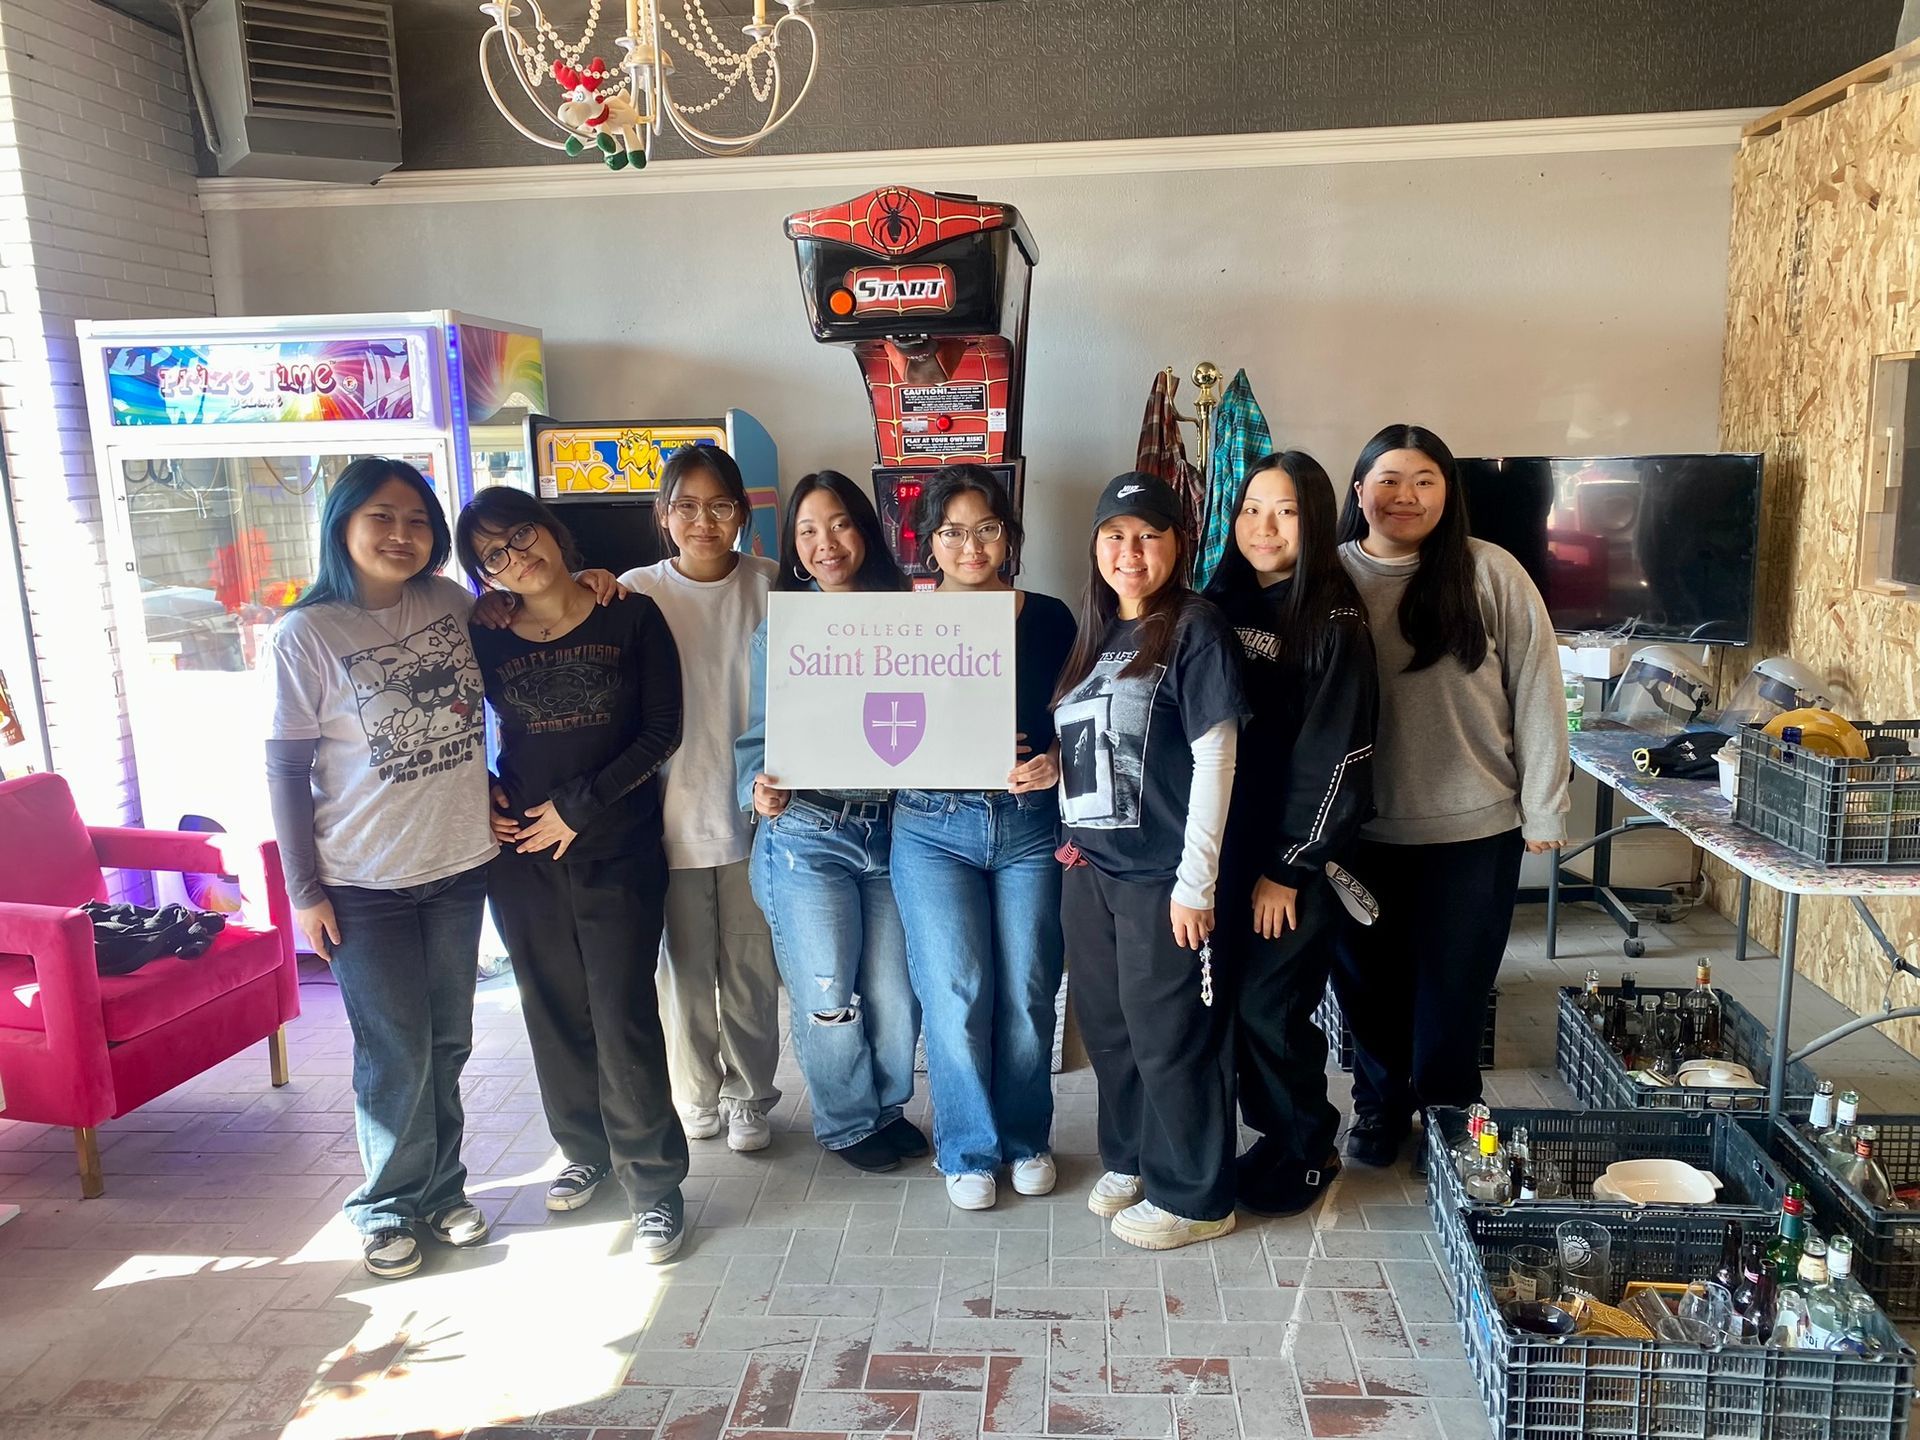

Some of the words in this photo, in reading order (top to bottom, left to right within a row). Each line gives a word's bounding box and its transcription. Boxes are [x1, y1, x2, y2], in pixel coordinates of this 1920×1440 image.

[857, 278, 945, 301] START
[660, 439, 697, 448] MIDWY
[827, 623, 923, 636] COLLEGE
[936, 624, 961, 636] OF
[789, 644, 865, 677] Saint
[873, 643, 1002, 677] Benedict
[526, 712, 611, 735] MOTORCYCLES
[391, 769, 418, 784] ND
